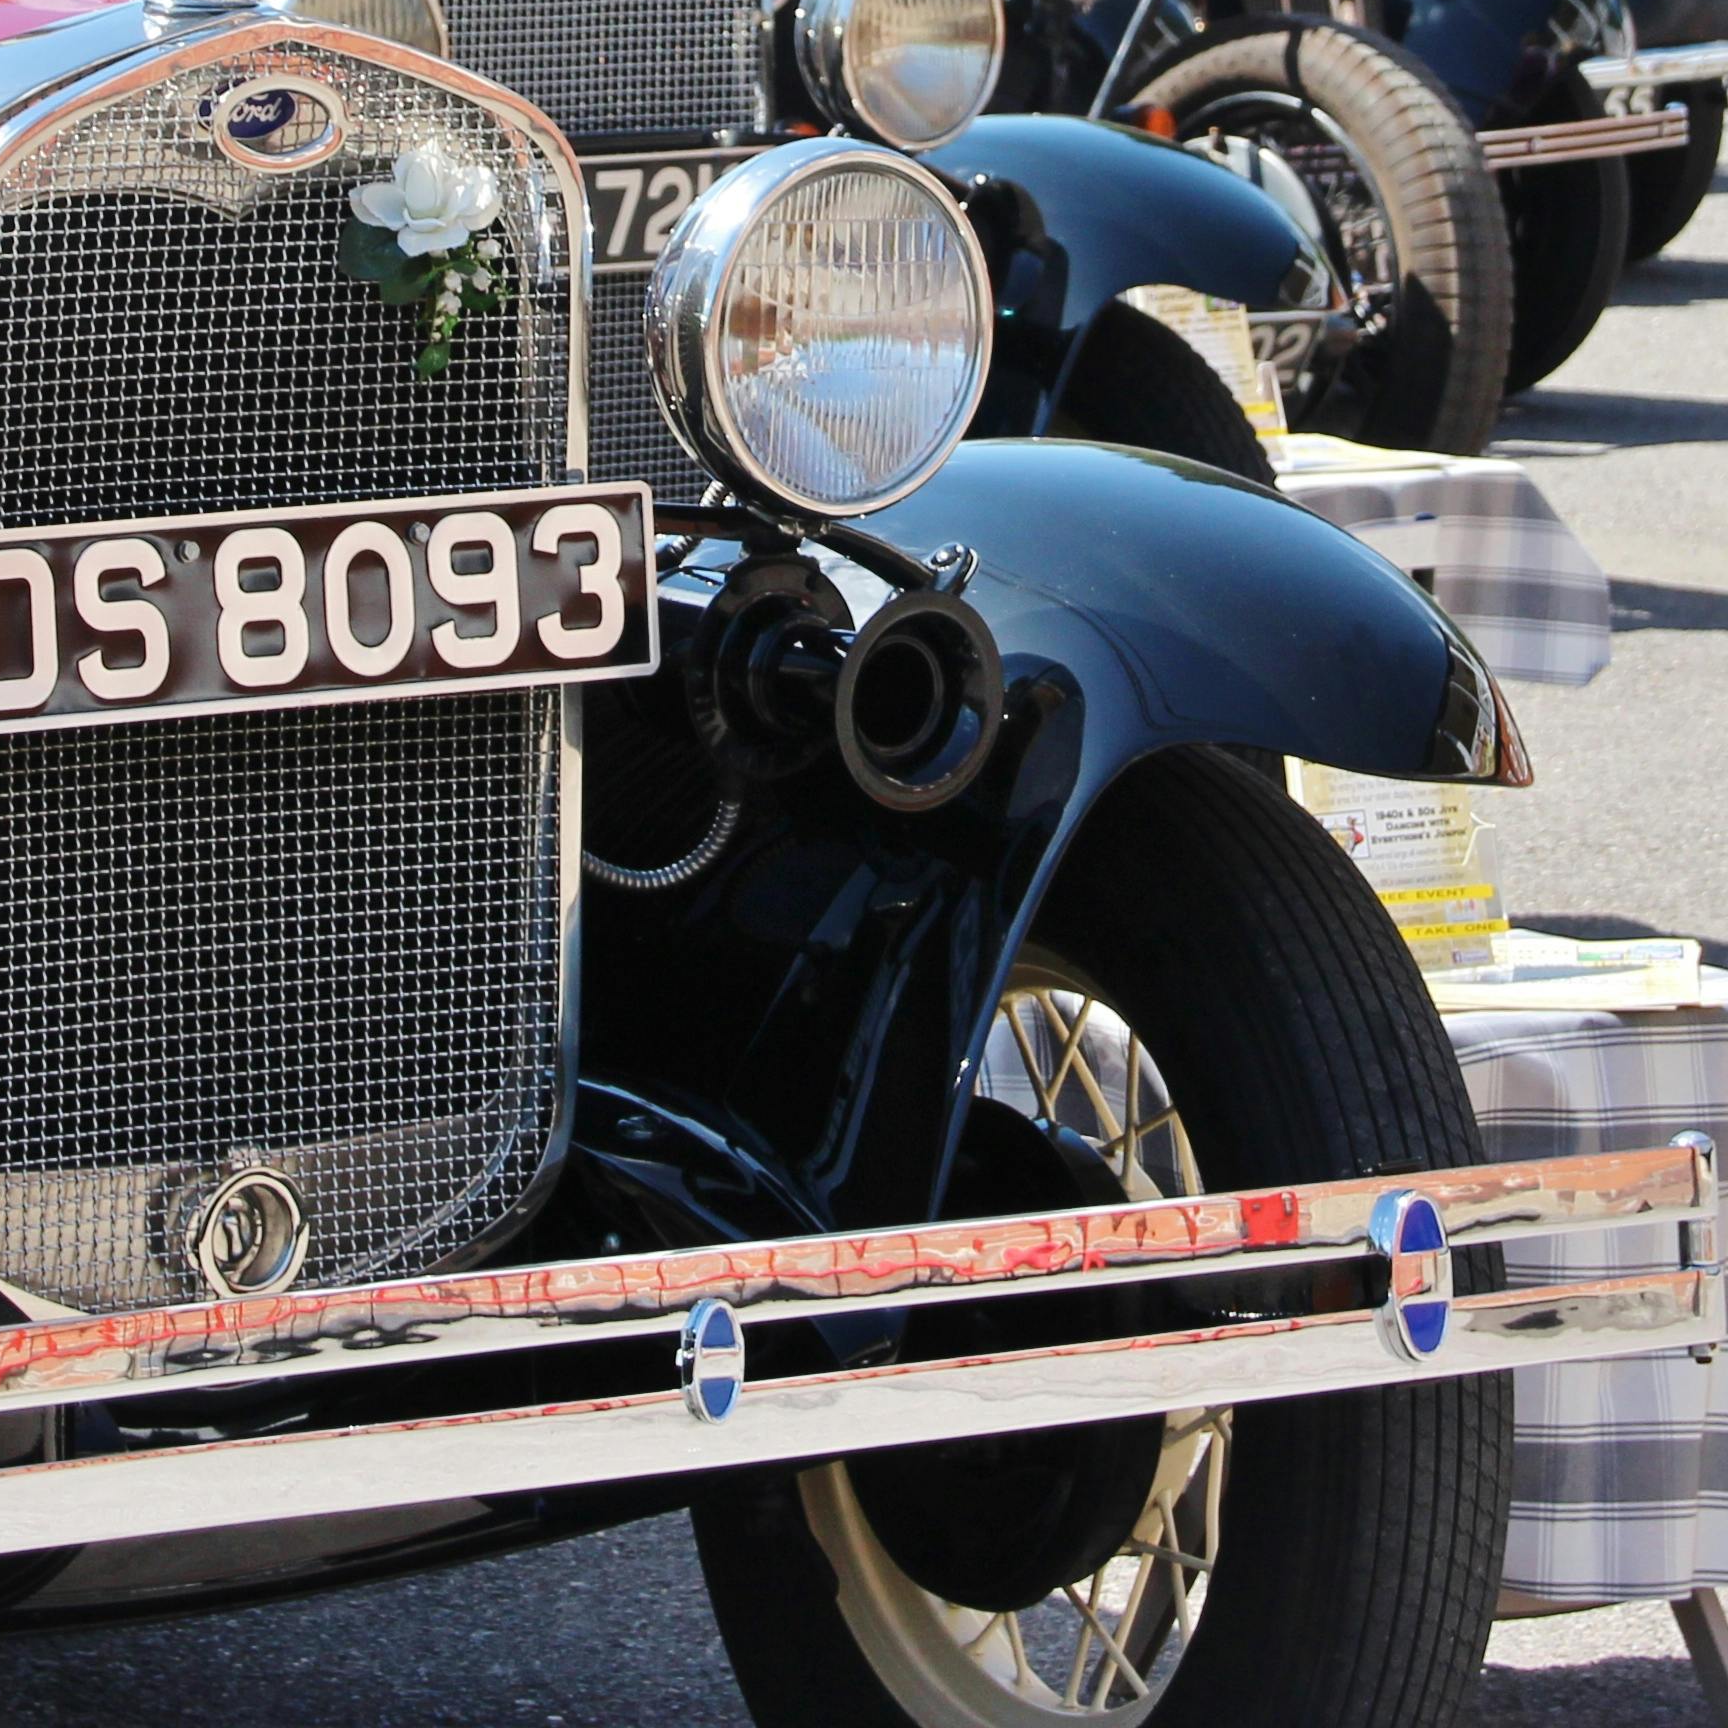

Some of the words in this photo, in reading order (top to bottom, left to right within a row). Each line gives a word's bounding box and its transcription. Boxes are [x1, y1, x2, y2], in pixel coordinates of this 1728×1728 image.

[229, 94, 282, 123] ord
[212, 503, 628, 688] 8093
[1415, 886, 1467, 900] EVENT
[1415, 924, 1457, 937] TAKE
[1463, 920, 1498, 933] ONE
